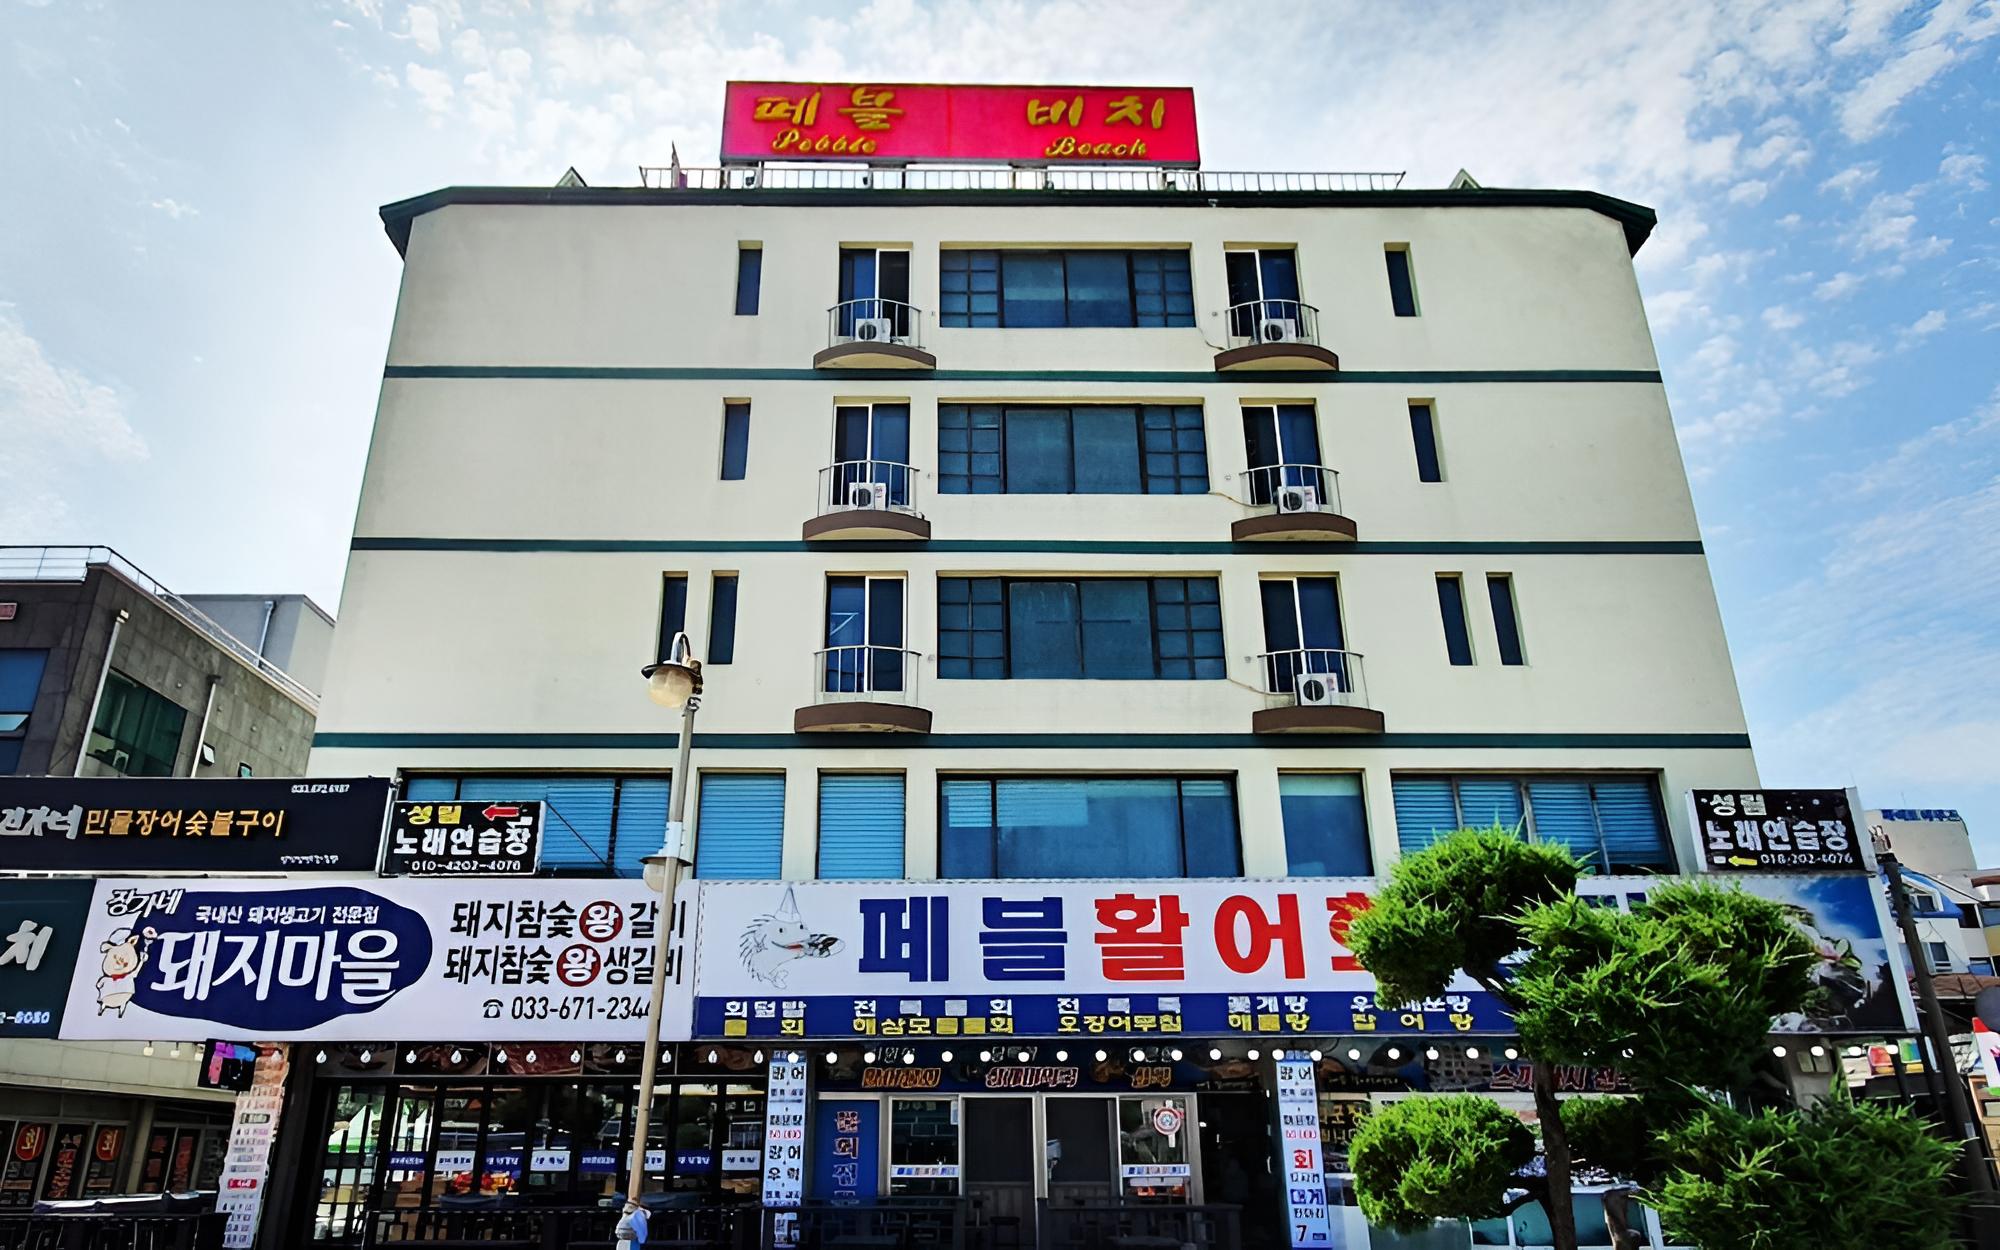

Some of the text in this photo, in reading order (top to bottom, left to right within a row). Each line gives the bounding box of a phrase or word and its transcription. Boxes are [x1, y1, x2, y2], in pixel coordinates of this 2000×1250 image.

[753, 87, 1165, 130] 페블 비치
[1045, 136, 1147, 156] Beach
[394, 824, 532, 856] 노래연습장
[1706, 820, 1849, 851] 노래연습장
[107, 888, 186, 918] 장가네
[196, 906, 380, 924] 국내산 돼지생고기 전문점
[858, 895, 1068, 982] 페블
[151, 929, 400, 1005] 돼지마을
[854, 999, 1013, 1017] 전회
[1351, 995, 1471, 1012] 우매운탕
[724, 1019, 804, 1036] 회
[853, 1016, 1014, 1035] 해삼모회
[1228, 1013, 1310, 1031] 해탕
